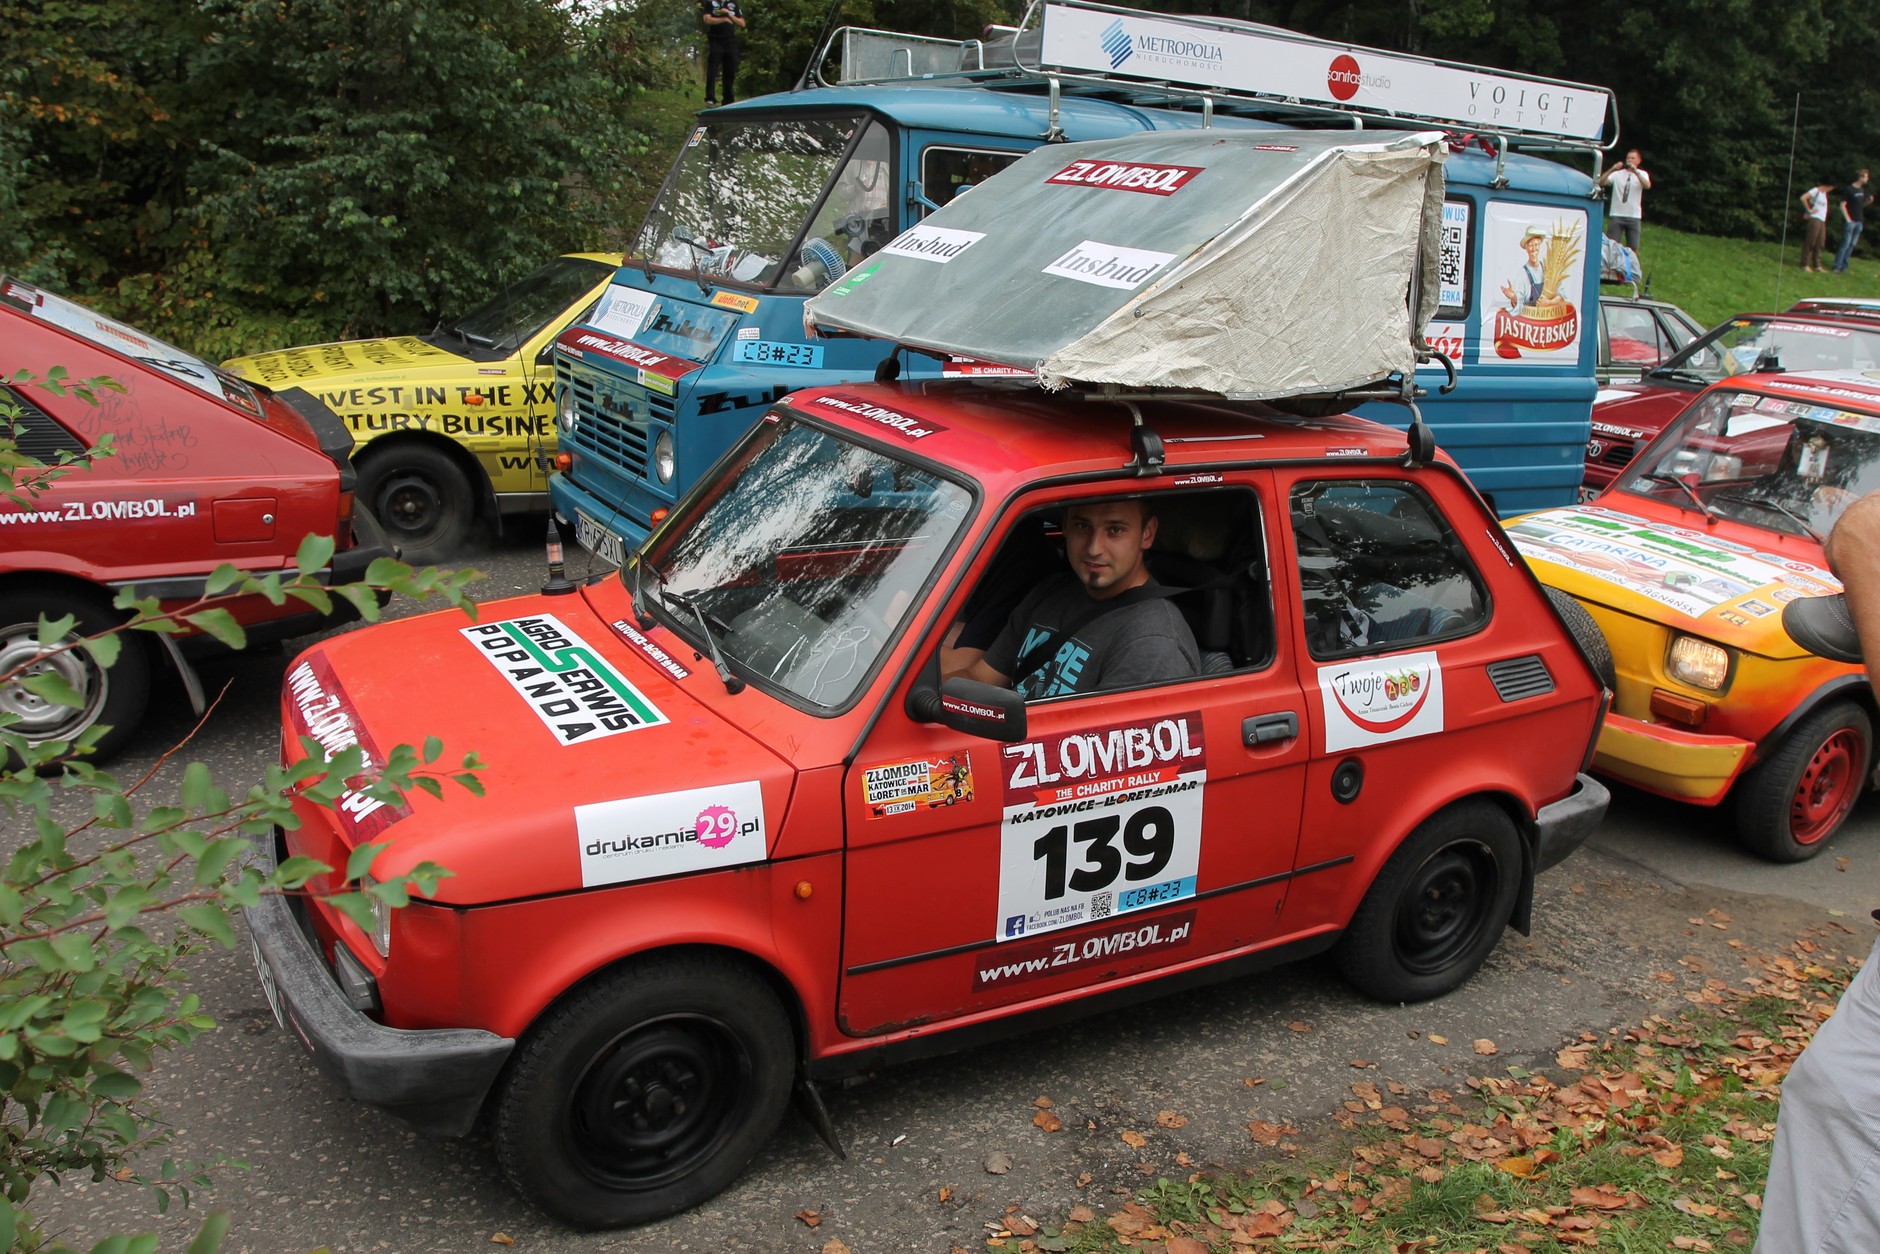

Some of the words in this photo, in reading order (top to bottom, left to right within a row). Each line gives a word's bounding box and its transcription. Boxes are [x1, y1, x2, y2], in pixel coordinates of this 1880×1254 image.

[1137, 34, 1223, 61] METROPOLIA
[1135, 53, 1223, 71] NIERUCHOMOŚCI
[1468, 80, 1574, 114] VOIGT
[1467, 102, 1569, 129] OPTYK
[1053, 162, 1188, 192] ZLOMBOL
[1454, 208, 1466, 222] US
[890, 231, 972, 258] Insbud
[1052, 248, 1161, 284] Insbud
[1522, 305, 1567, 322] makarony
[1500, 315, 1576, 348] JASTRZĘBSKIE
[577, 334, 668, 366] www.ZLOMBOL.pl
[743, 342, 814, 366] CB#23
[415, 386, 446, 406] IN
[456, 384, 511, 407] THE
[442, 414, 557, 436] BUSINE
[816, 396, 934, 439] www.ZLOMBOL.pl
[1174, 475, 1223, 486] www.ZLOMBOL.pl
[0, 499, 195, 525] www.ZLOMBOL.pl
[1548, 534, 1668, 568] CATARINA
[467, 624, 597, 741] POPANDA
[1335, 671, 1382, 707] Twoje
[1388, 676, 1418, 699] ABC
[942, 701, 1005, 720] www.ZLOMBOL.pl
[1003, 718, 1202, 790] ZLOMBOL
[868, 778, 907, 792] KATOWICE
[908, 783, 929, 795] MAR
[1056, 788, 1073, 801] THE
[1076, 779, 1125, 797] CHARITY
[1127, 772, 1161, 787] RALLY
[1165, 780, 1199, 795] MAR
[901, 802, 915, 812] 2014
[1032, 806, 1175, 901] 139
[1126, 881, 1181, 908] CB#23
[1043, 908, 1060, 918] POLUB
[1060, 905, 1070, 914] NAS
[1070, 904, 1078, 912] NA
[980, 922, 1190, 984] www.ZLOMBOL.pl
